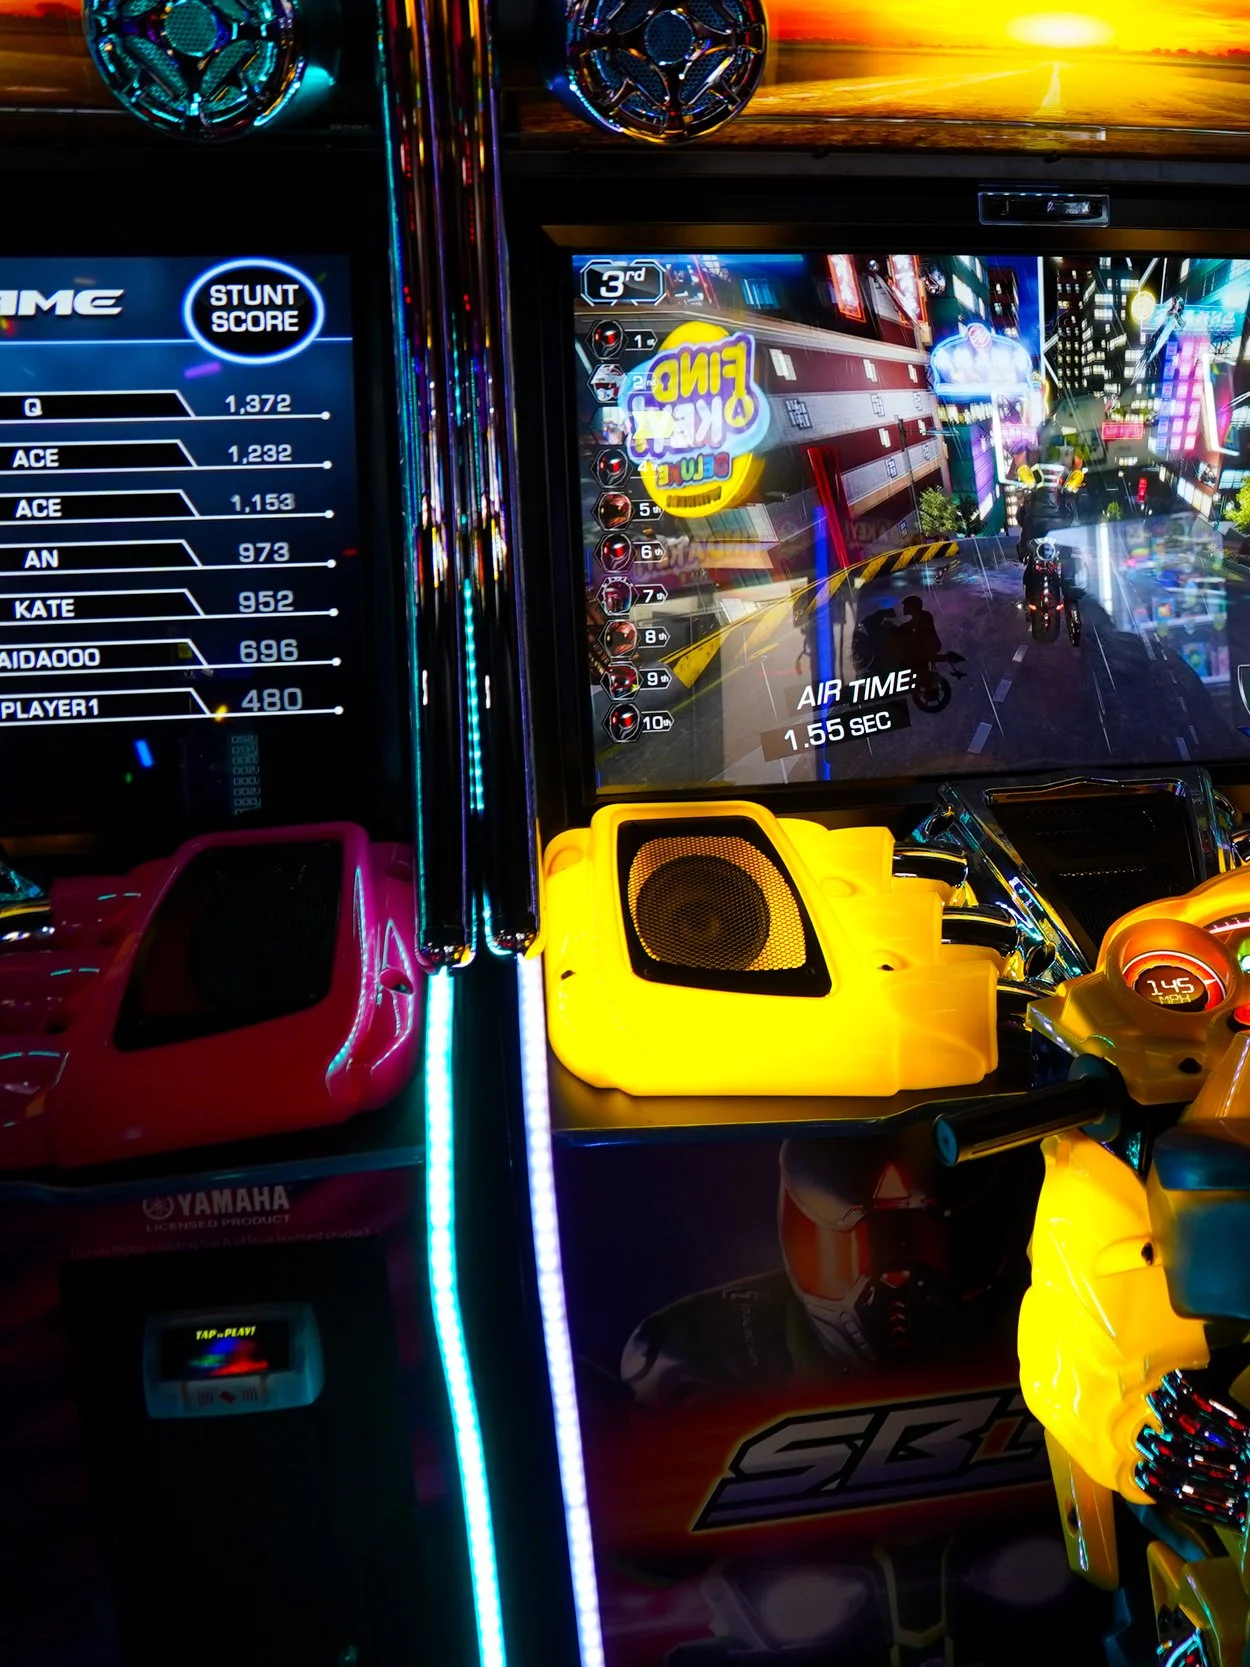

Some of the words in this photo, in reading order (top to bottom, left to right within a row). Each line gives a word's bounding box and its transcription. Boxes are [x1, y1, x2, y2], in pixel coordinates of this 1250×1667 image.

[600, 267, 646, 298] 3rd
[210, 284, 299, 306] STUNT
[211, 310, 299, 333] SCORE
[24, 397, 43, 417] Q
[225, 394, 291, 416] 1,372
[12, 448, 59, 468] ACE
[228, 444, 292, 465] 1,232
[15, 498, 62, 518] ACE
[230, 493, 295, 513] 1,153
[24, 549, 59, 569] AN
[238, 541, 290, 563] 973
[15, 599, 75, 619] KATE
[238, 590, 295, 613] 952
[239, 639, 299, 662] 696
[796, 679, 842, 710] AIR
[848, 669, 917, 703] TIME:
[1, 699, 100, 719] PLAYER1
[241, 688, 303, 712] 480
[784, 718, 845, 751] 1.55
[849, 711, 892, 737] SEC
[1147, 977, 1195, 996] 145
[177, 1184, 291, 1217] YAMAHA
[145, 1219, 217, 1234] LICENSED
[221, 1213, 292, 1228] PRODUCT
[195, 1329, 217, 1341] TAP
[224, 1326, 257, 1338] PLAY!
